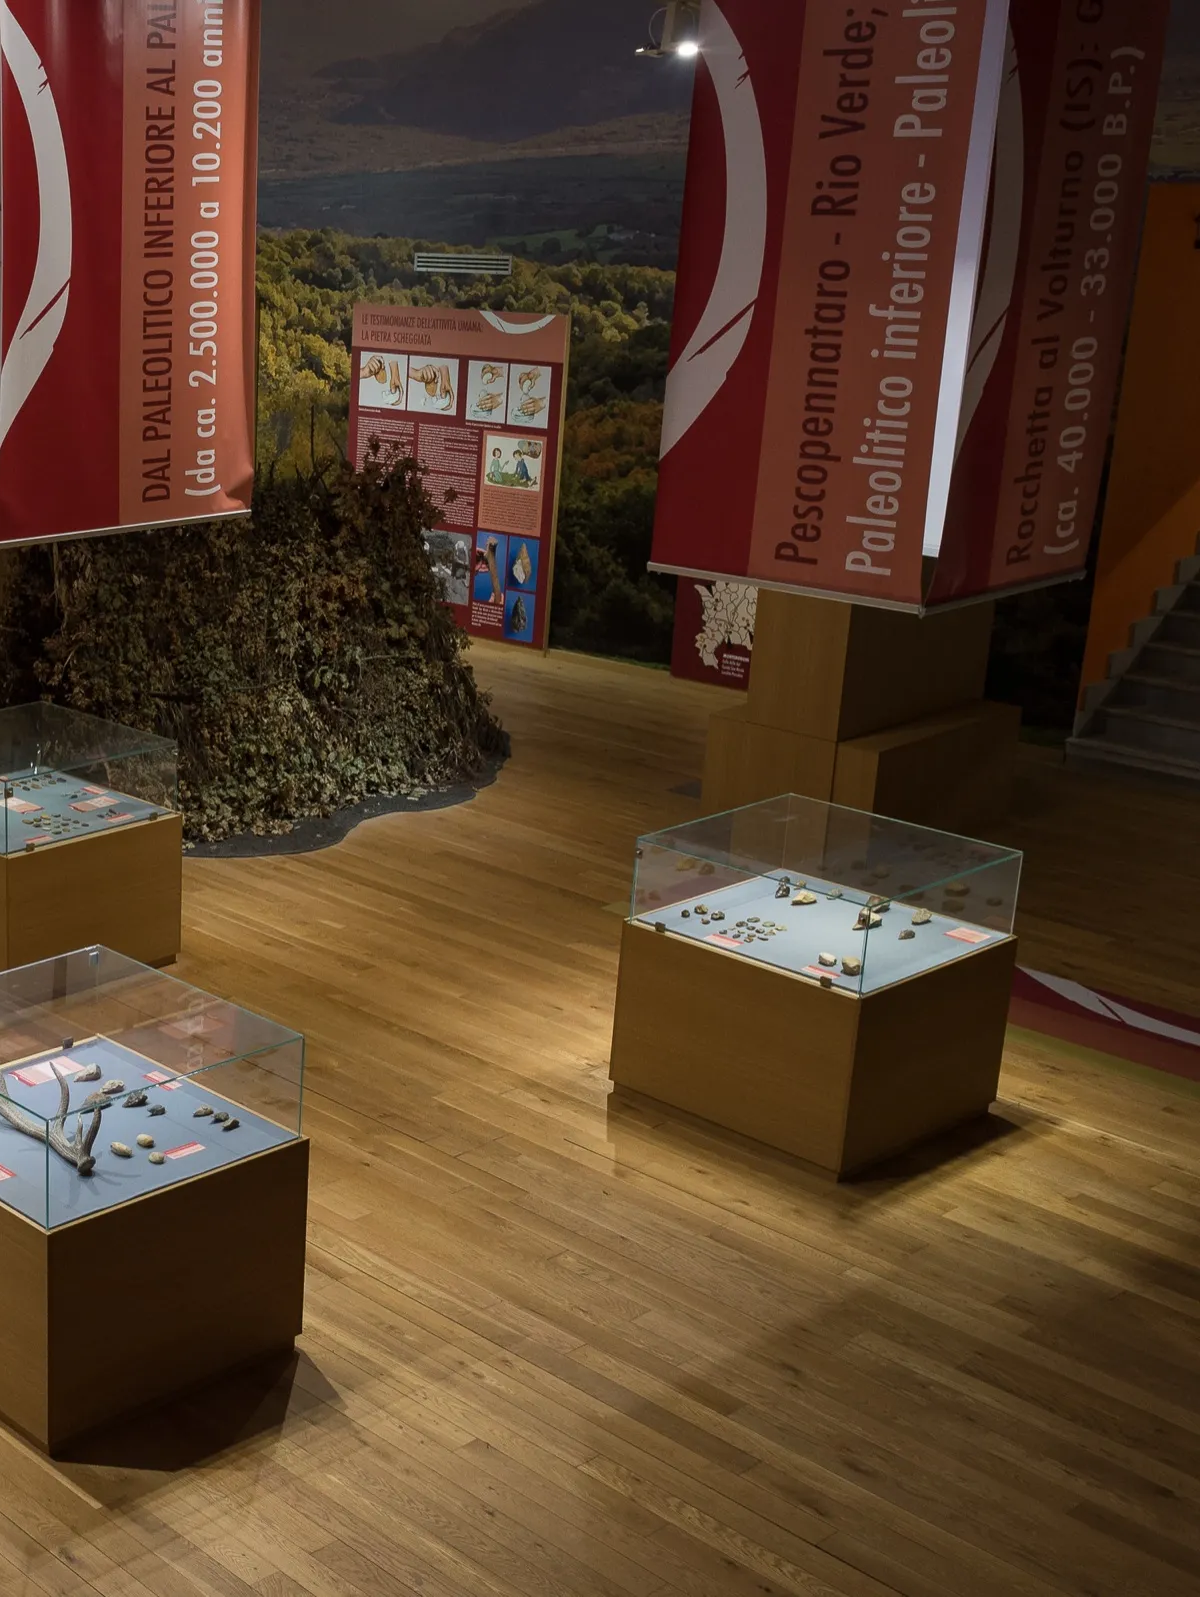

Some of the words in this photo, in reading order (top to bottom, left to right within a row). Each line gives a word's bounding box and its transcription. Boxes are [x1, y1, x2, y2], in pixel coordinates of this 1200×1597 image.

[146, 59, 176, 97] AL
[818, 8, 889, 140] Verde;
[1059, 43, 1104, 131] (IS):
[1102, 46, 1146, 136] B.P.)
[143, 105, 175, 258] INFERIORE
[191, 79, 222, 187] 10.200
[200, 202, 220, 219] a
[810, 154, 862, 217] Rio
[1080, 153, 1123, 297] 33.000
[868, 182, 936, 359] inferiore
[1037, 150, 1085, 321] Volturno
[142, 269, 173, 442] PALEOLITICO
[188, 230, 219, 388] 2.500.000
[361, 330, 369, 341] LA
[371, 331, 391, 343] PIETRA
[393, 332, 432, 346] SCHEGGIATA
[362, 314, 369, 325] LE
[370, 314, 416, 329] TESTIMONIANZE
[1031, 334, 1061, 370] al
[197, 398, 216, 438] ca.
[774, 259, 850, 565] Pescopennataro
[1057, 336, 1099, 473] 40.000
[142, 449, 171, 503] DAL
[184, 448, 222, 497] (da
[845, 376, 913, 576] Paleolitico
[1005, 386, 1053, 566] Rocchetta
[1043, 487, 1080, 555] (ca.
